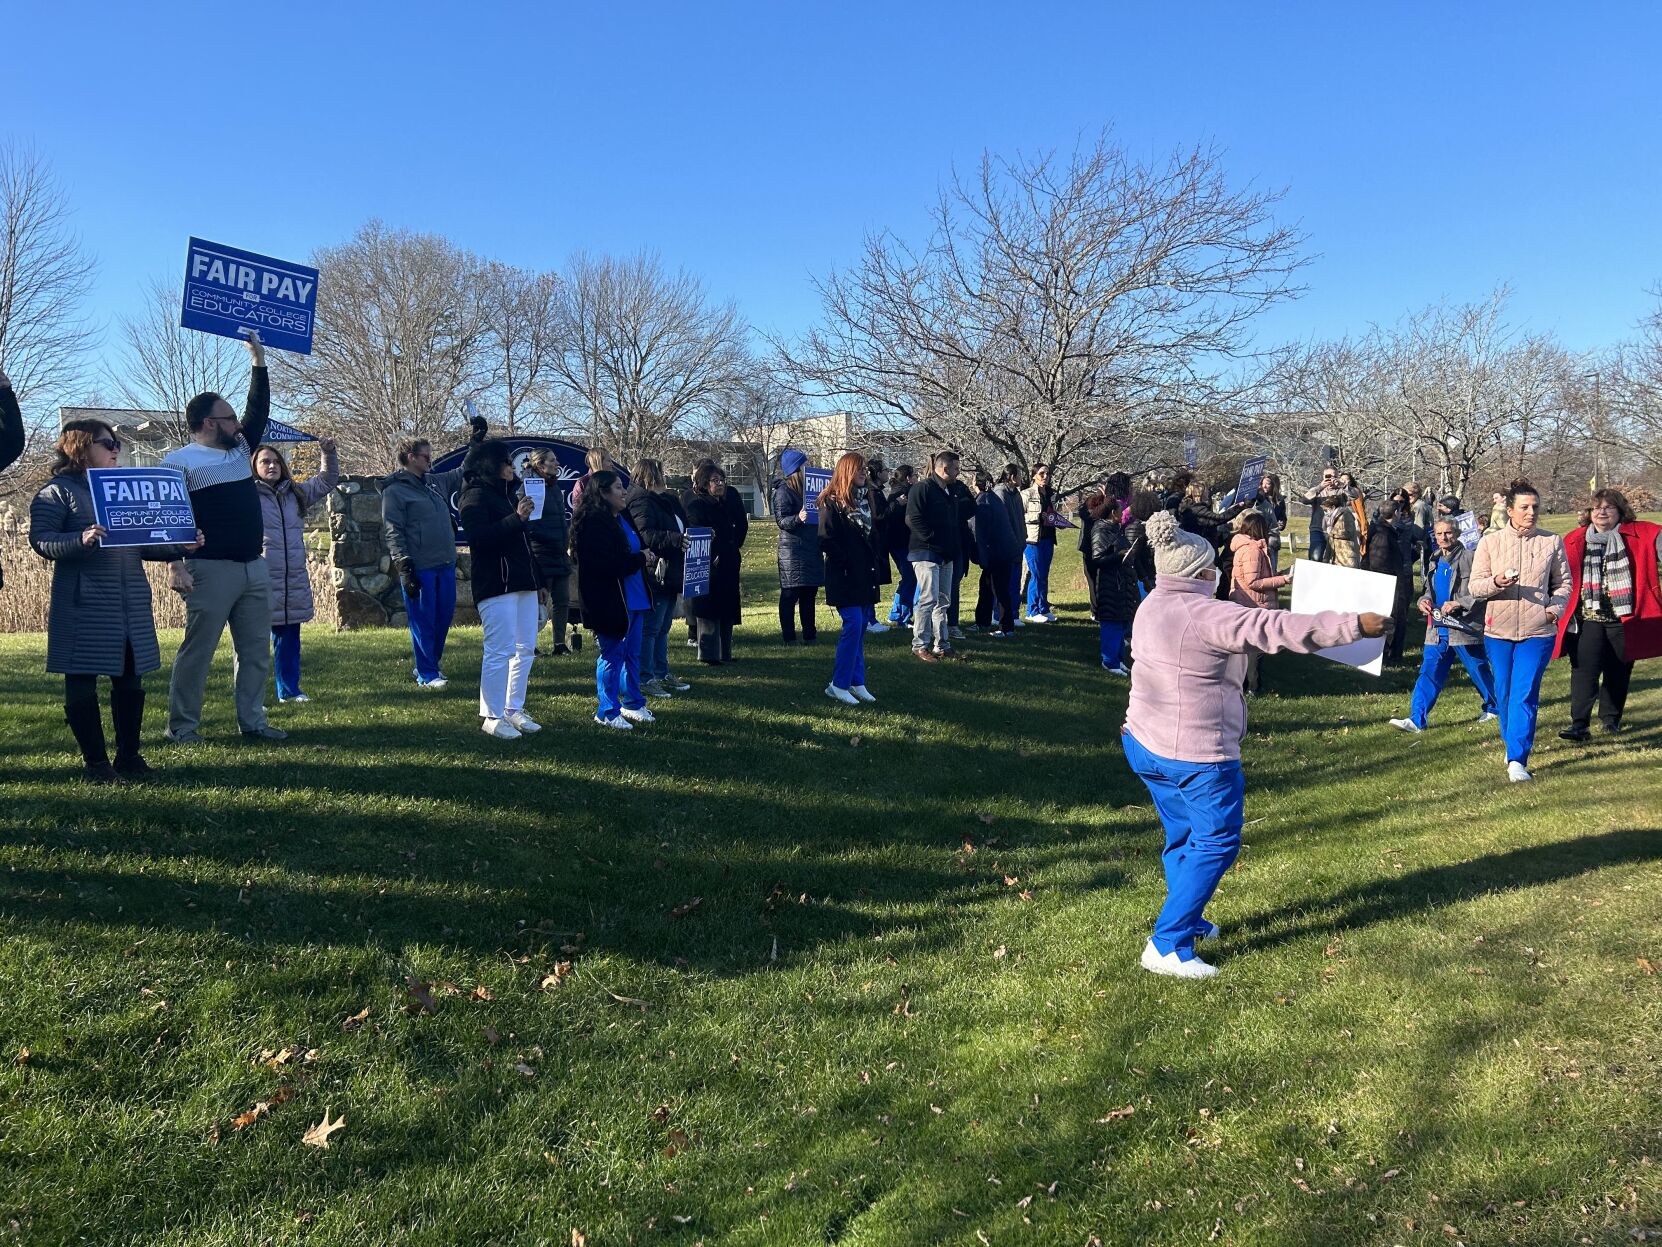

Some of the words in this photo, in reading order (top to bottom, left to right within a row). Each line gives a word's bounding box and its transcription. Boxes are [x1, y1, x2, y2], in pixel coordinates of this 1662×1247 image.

[191, 253, 256, 292] FAIR
[261, 271, 313, 304] PAY
[191, 288, 258, 309] COMMUNITY
[258, 304, 307, 321] COLLEGE
[245, 293, 258, 301] FOR
[190, 295, 307, 332] EDUCATORS
[102, 480, 155, 502] FAIR
[805, 476, 825, 492] FAIR
[111, 516, 193, 526] EDUCATORS
[686, 540, 701, 559] FAIR
[686, 570, 709, 581] EDUCATORS
